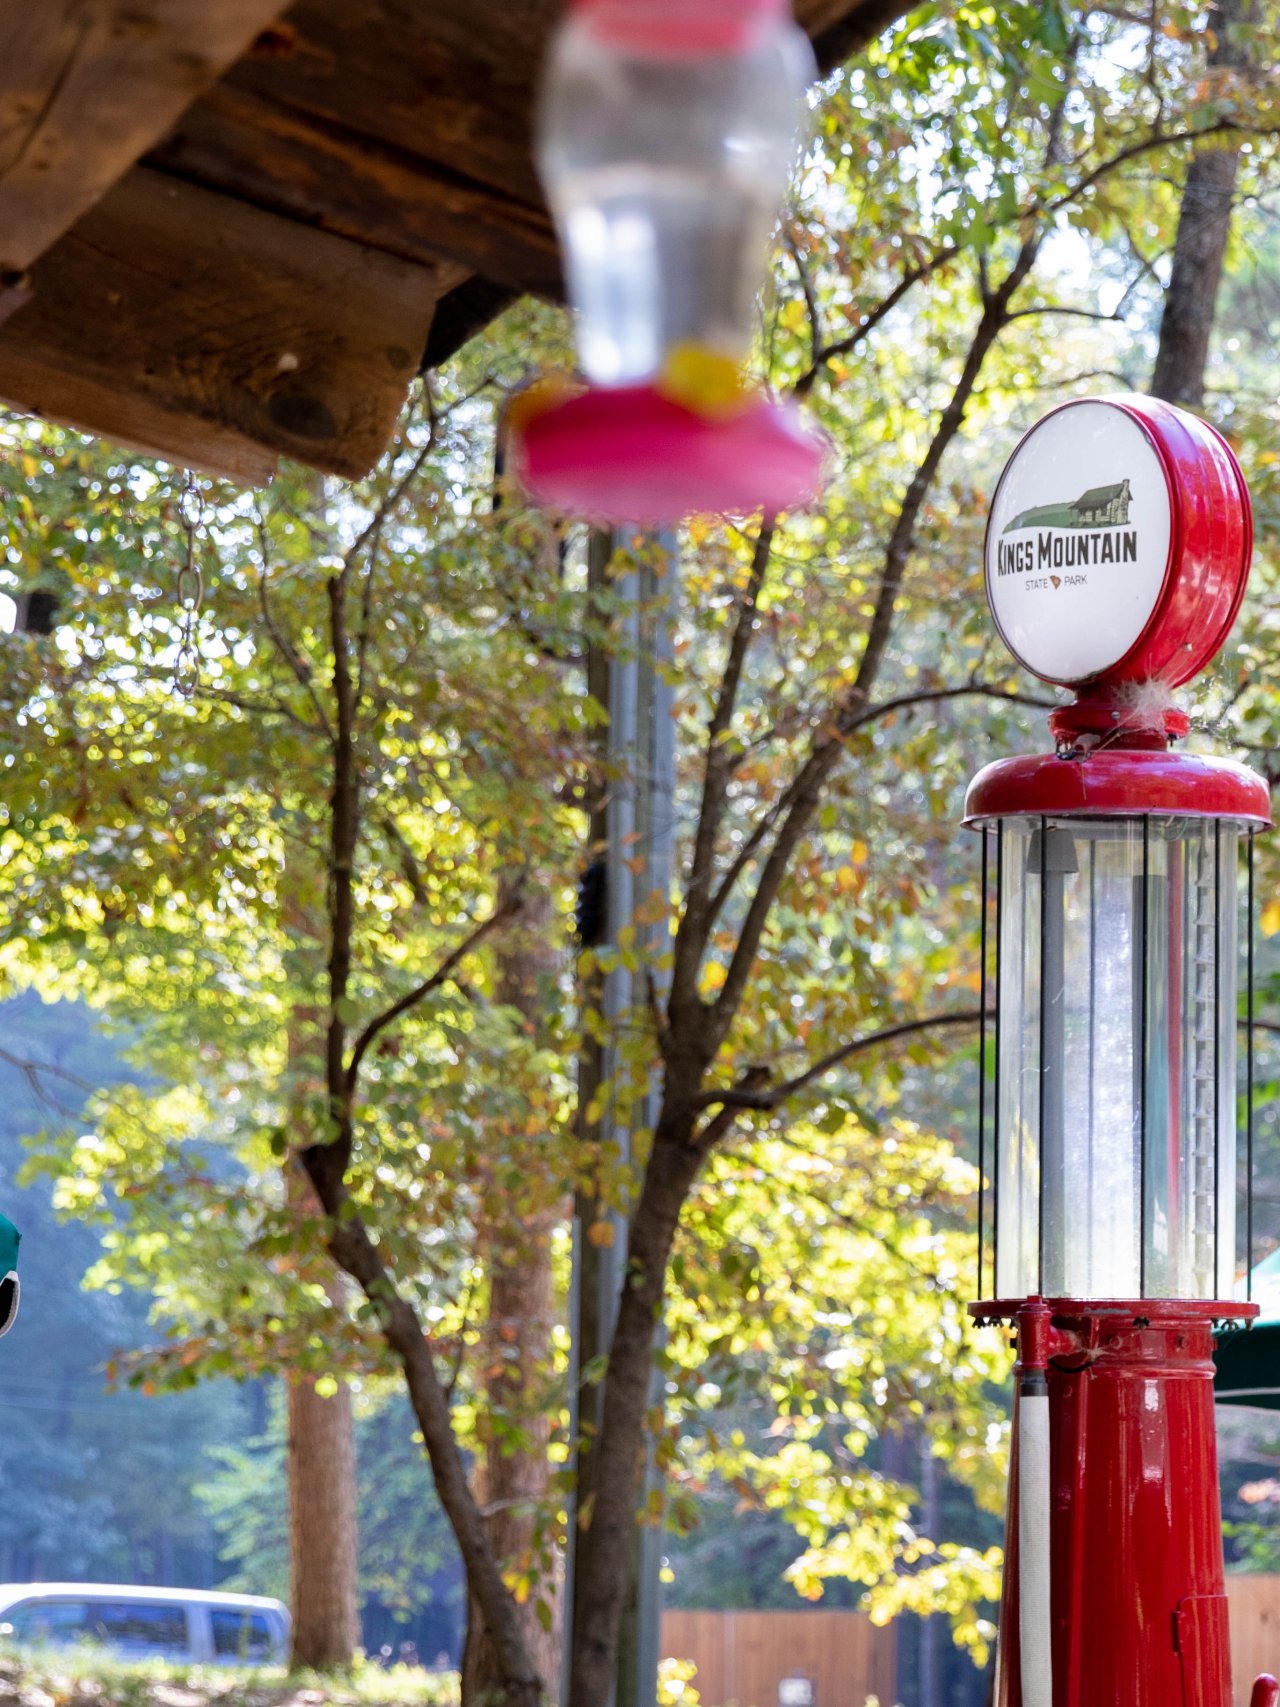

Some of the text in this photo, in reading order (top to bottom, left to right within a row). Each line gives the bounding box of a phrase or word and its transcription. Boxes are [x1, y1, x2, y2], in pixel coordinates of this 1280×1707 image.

[998, 531, 1137, 576] KINGS MOUNTAIN
[1025, 575, 1087, 591] STATE PARK
